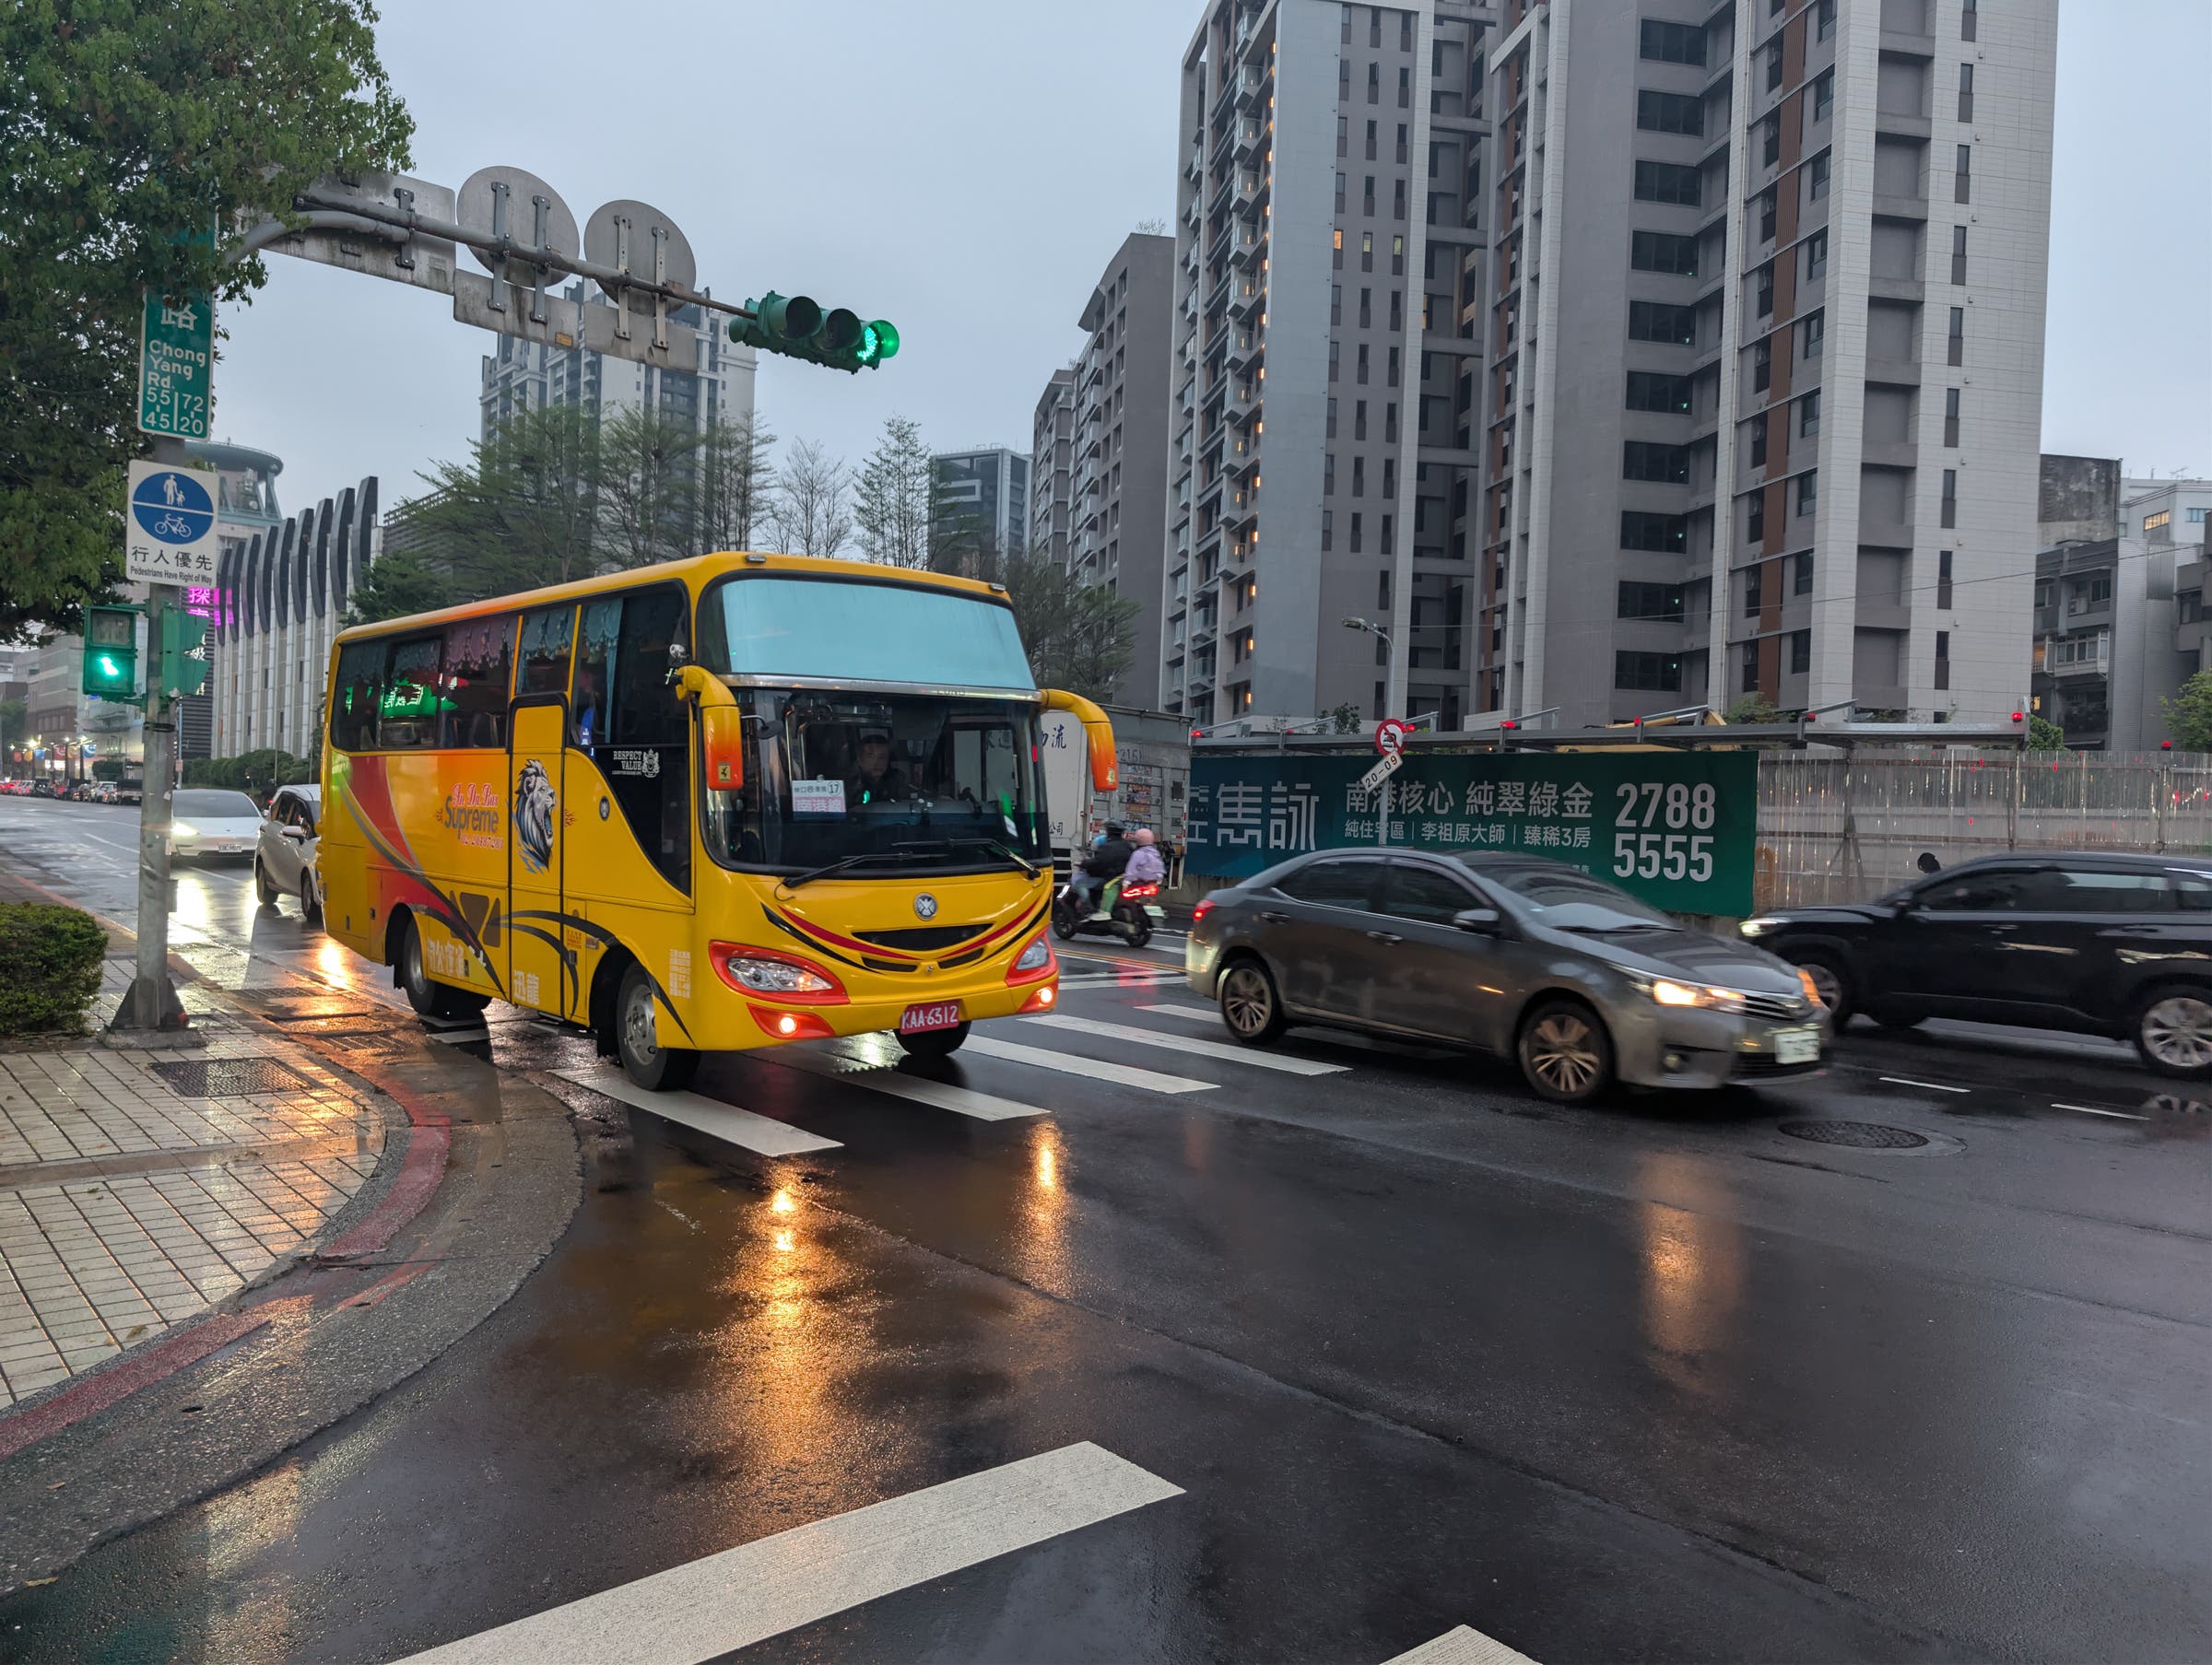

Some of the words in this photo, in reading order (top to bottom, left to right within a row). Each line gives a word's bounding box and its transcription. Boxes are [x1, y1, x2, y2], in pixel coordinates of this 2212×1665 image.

[148, 339, 206, 368] Chong
[147, 370, 175, 390] Rd.
[148, 355, 193, 381] Yang
[147, 387, 171, 405] 55
[182, 393, 204, 413] 72
[145, 412, 171, 429] 45
[180, 416, 204, 435] 20
[132, 545, 213, 571] 行人優先
[130, 566, 163, 579] Pedestrians
[164, 570, 178, 580] Have
[179, 571, 194, 583] Right
[201, 574, 213, 586] Way
[613, 750, 642, 760] RESPECT
[621, 760, 642, 770] VALUE
[829, 783, 840, 793] 17
[1465, 780, 1594, 818] 純翠綠金
[444, 795, 500, 839] Supreme
[1615, 782, 1716, 829] 2788
[1421, 822, 1505, 845] 李祖原大師
[1524, 824, 1592, 848] 臻稀3房
[1613, 833, 1714, 882] 5555
[900, 1005, 959, 1030] KAA-6312
